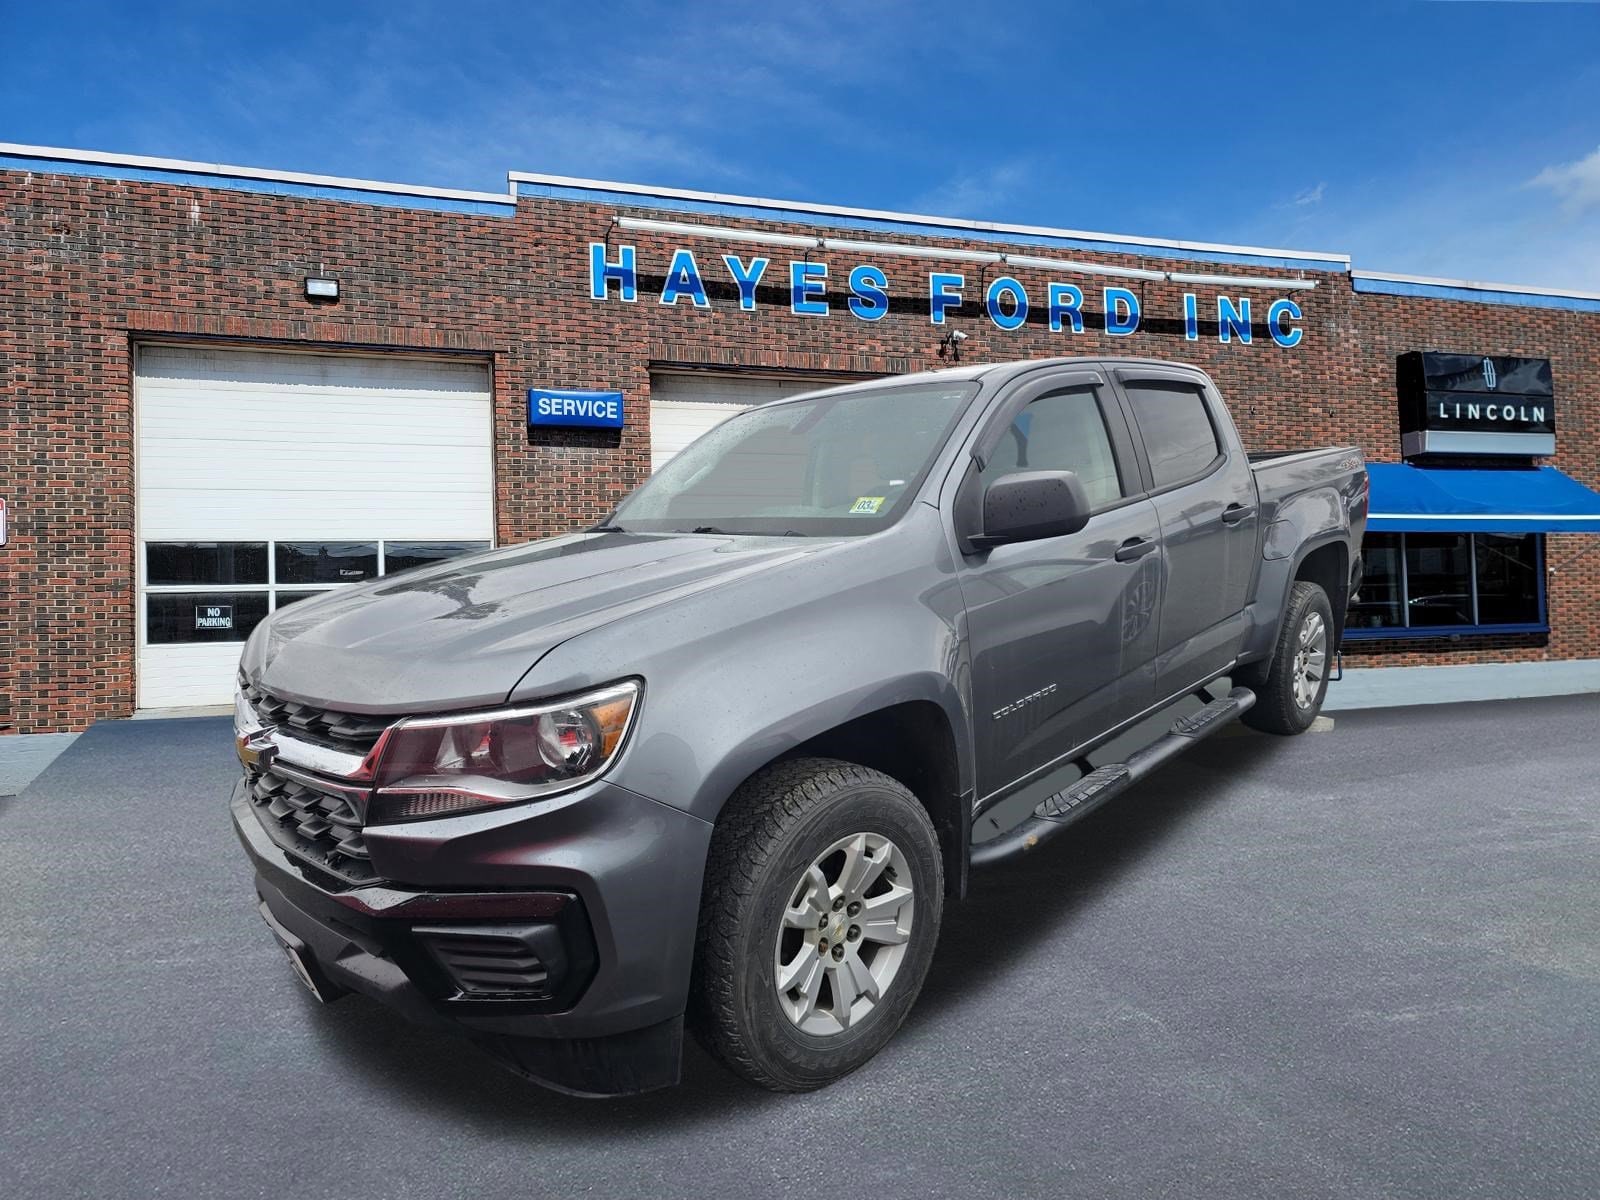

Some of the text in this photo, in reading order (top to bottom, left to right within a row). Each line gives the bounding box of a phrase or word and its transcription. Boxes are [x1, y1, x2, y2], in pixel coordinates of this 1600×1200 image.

[589, 242, 1304, 349] HAYES FORD INC
[538, 397, 618, 419] SERVICE
[1439, 402, 1546, 423] LINCOLN
[197, 617, 231, 627] PARKING
[207, 607, 221, 617] NO
[992, 683, 1057, 720] COLORADO
